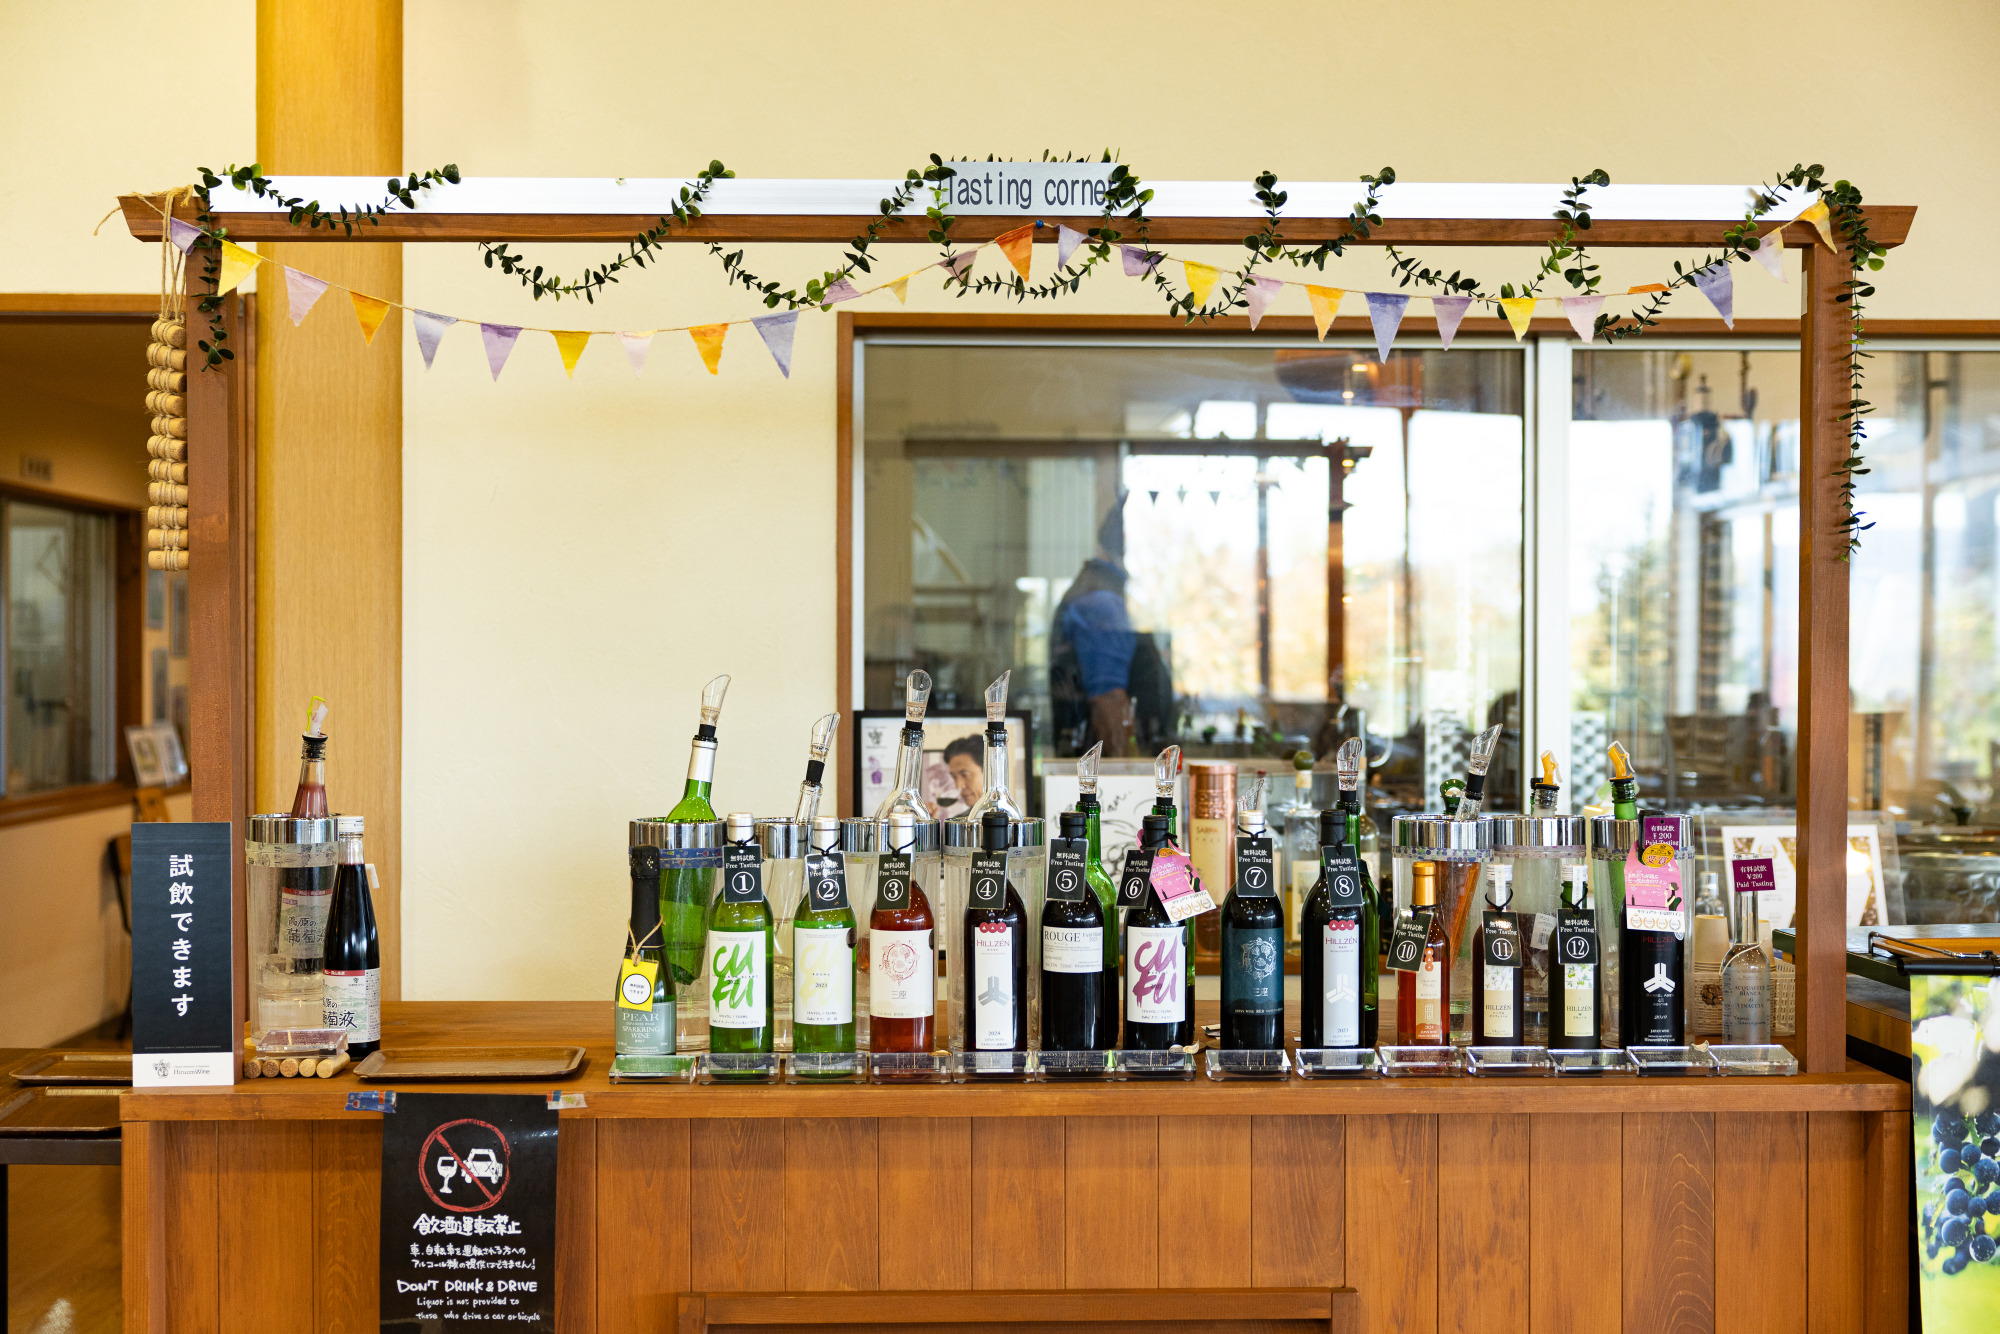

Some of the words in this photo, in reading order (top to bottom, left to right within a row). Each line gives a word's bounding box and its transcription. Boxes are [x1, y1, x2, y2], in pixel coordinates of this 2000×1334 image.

[1402, 923, 1424, 932] 無料試飲
[168, 854, 194, 1017] 試飲できます
[1044, 930, 1080, 942] ROUGE
[1408, 931, 1426, 940] Tasting
[623, 1012, 660, 1020] PEAR
[412, 1213, 522, 1236] 飲酒運転禁止
[396, 1280, 439, 1293] DON'T
[486, 1281, 494, 1292] &
[497, 1280, 538, 1292] DRIVE
[416, 1297, 444, 1308] Liquor
[446, 1297, 454, 1306] is
[473, 1296, 506, 1308] provided
[416, 1312, 438, 1320] those
[444, 1310, 459, 1320] who
[462, 1312, 482, 1320] drive
[518, 1311, 540, 1323] bicycle
